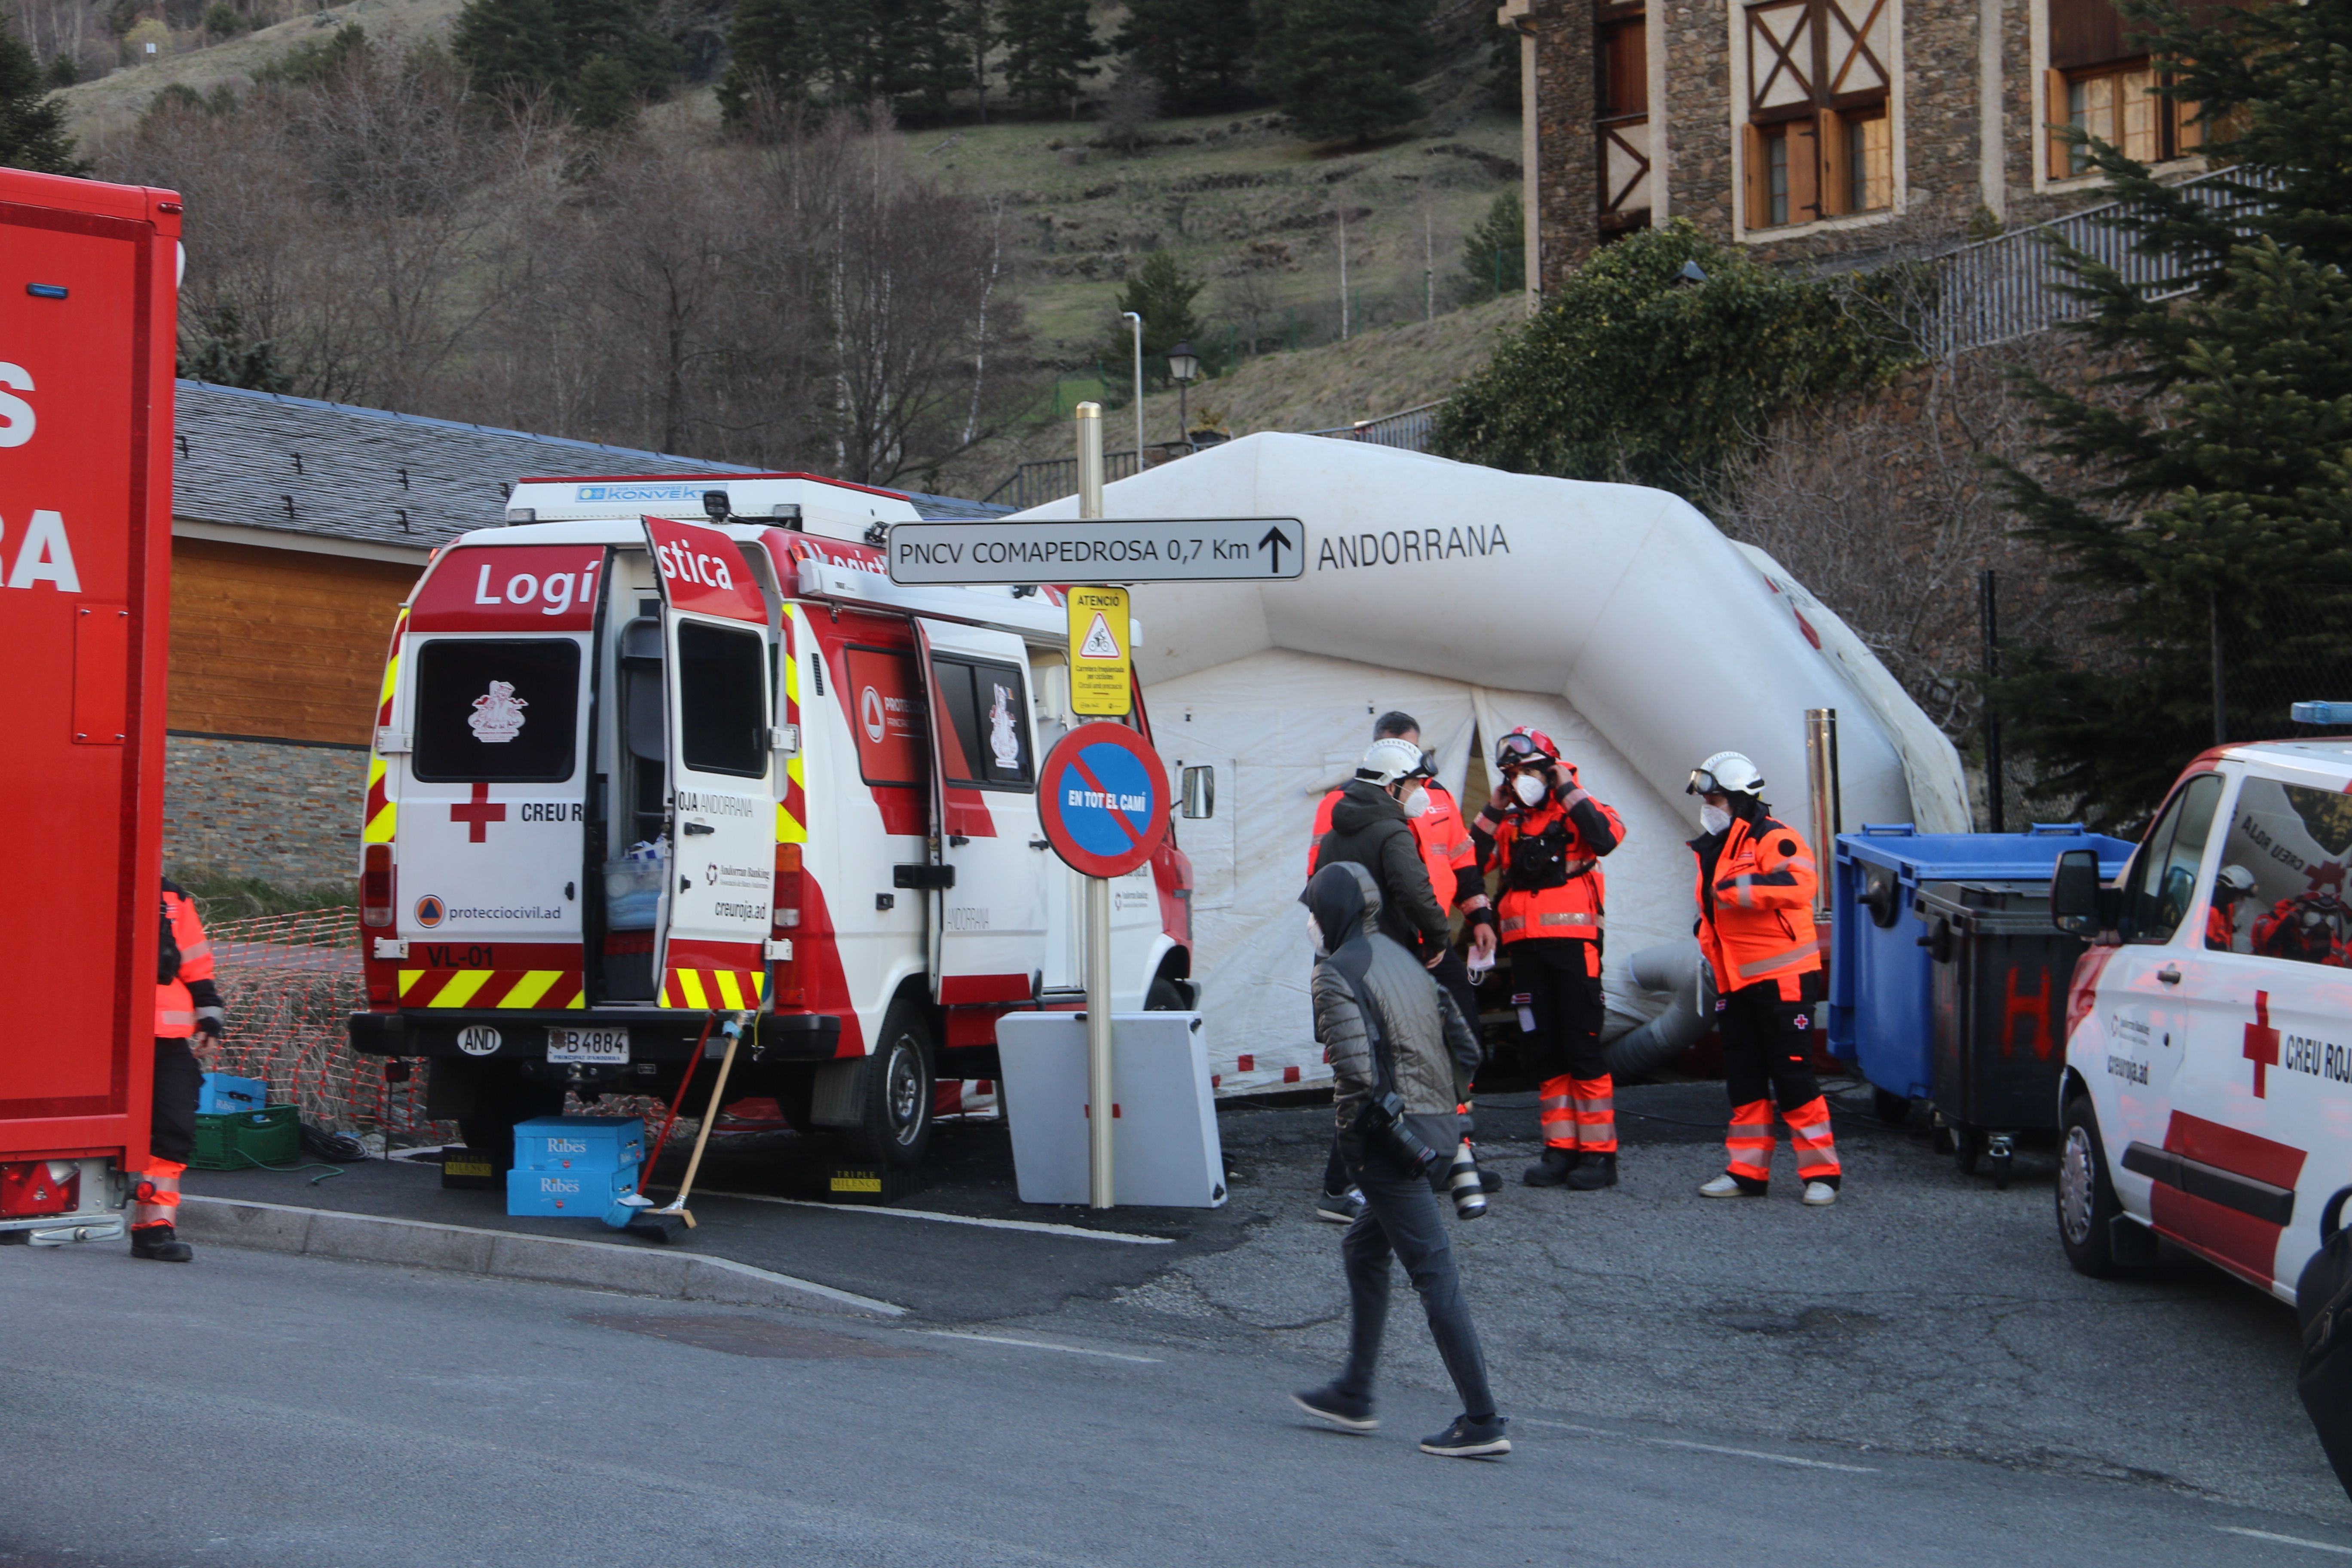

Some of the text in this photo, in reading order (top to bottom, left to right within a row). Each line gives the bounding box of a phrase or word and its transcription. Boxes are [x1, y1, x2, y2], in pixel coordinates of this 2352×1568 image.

[608, 486, 705, 500] KONVEK
[0, 509, 82, 592] A
[900, 539, 1250, 565] PNCV COMAPEDROSA 0,7 Km
[1318, 524, 1510, 571] ANDORRANA
[1077, 593, 1120, 606] ATENCIÓ
[521, 803, 566, 822] CREU
[700, 793, 753, 818] ANDORRANA
[1068, 789, 1146, 812] EN TOT EL CAMÍ
[720, 864, 770, 882] Andorran Banking
[449, 906, 561, 921] protecciocivil.ad
[714, 900, 766, 922] creuroja.ad
[427, 945, 493, 967] VL-01
[464, 1028, 496, 1050] AND
[2285, 1034, 2352, 1084] CREU ROJ
[2108, 1054, 2148, 1087] creuroja.ad
[547, 1138, 586, 1152] Ribes
[450, 1155, 488, 1163] TRIPLE
[832, 1179, 879, 1187] MILENCO
[836, 1170, 876, 1178] TRIPLE
[540, 1178, 580, 1193] Ribes
